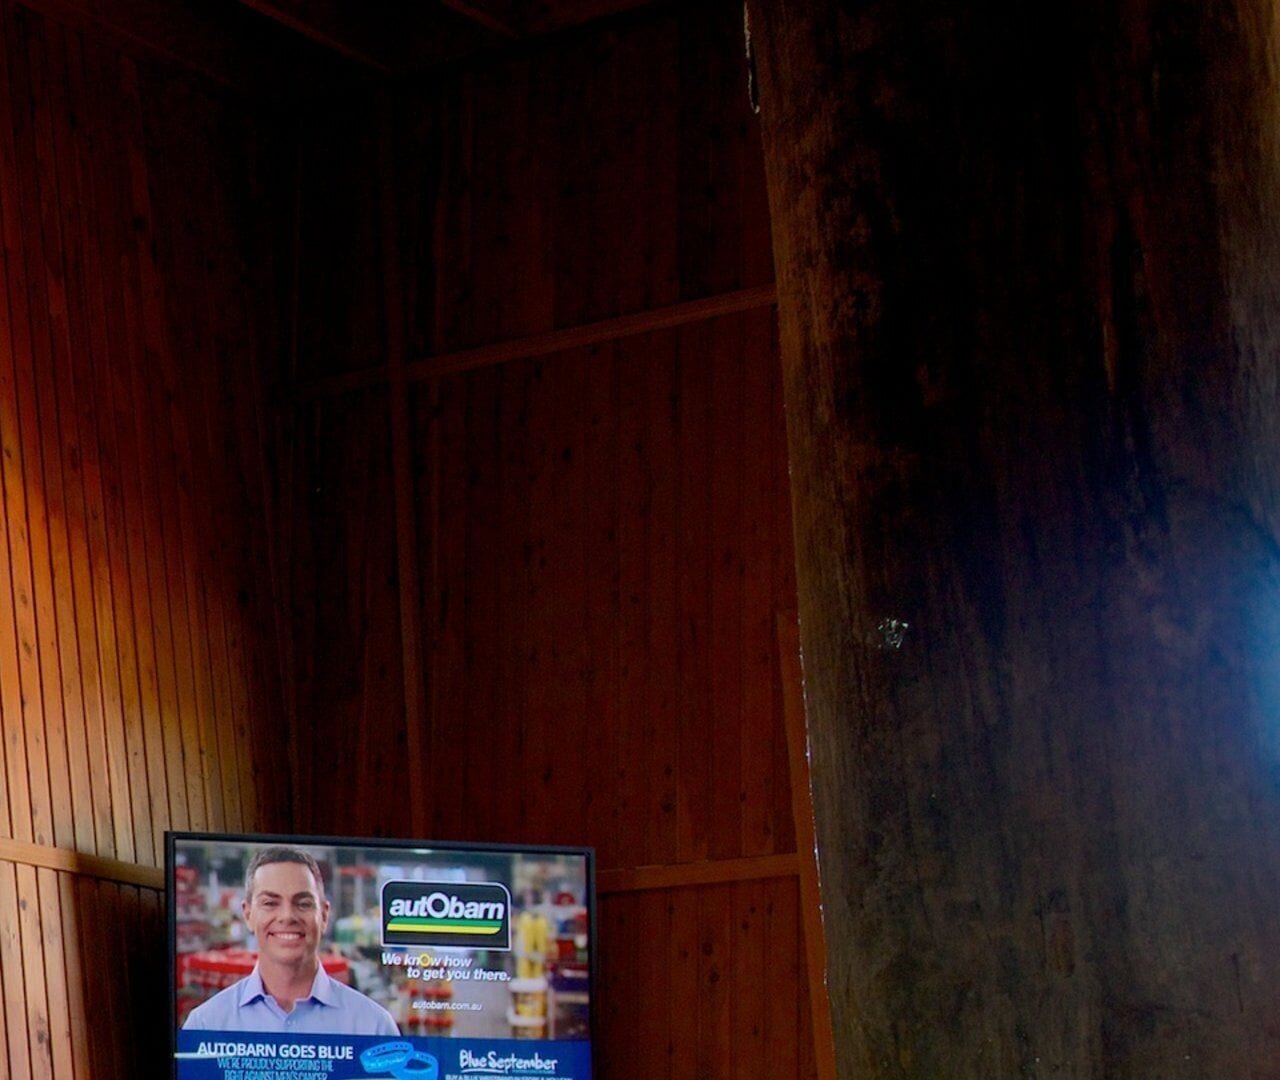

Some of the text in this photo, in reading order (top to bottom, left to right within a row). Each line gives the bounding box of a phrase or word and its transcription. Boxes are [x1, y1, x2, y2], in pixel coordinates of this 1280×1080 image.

[381, 953, 402, 966] We
[443, 955, 473, 968] how
[407, 967, 512, 982] to get you there.
[412, 1000, 482, 1011] autobarn.com.au
[196, 1042, 354, 1060] AUTOBARN GOES BLUE
[459, 1049, 558, 1074] Blue September
